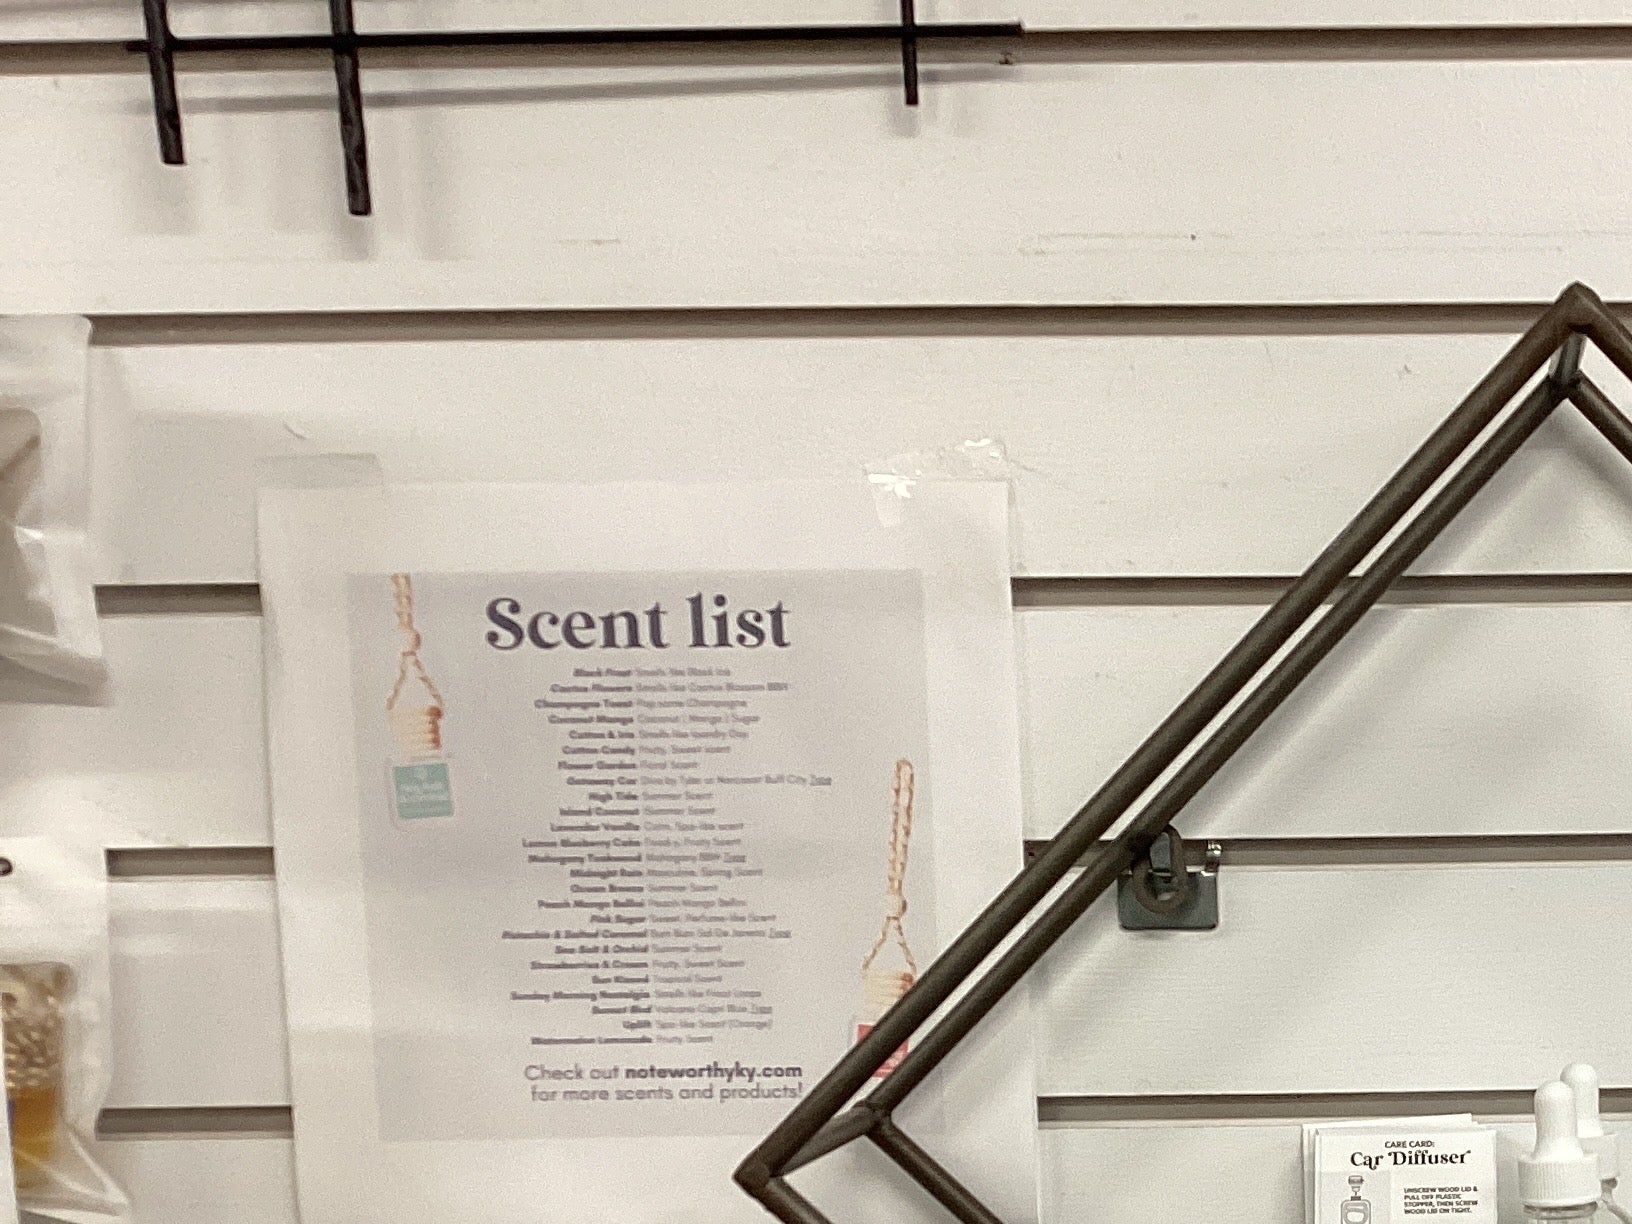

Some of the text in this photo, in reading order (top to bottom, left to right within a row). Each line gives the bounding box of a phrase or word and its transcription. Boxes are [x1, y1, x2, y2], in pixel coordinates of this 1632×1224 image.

[485, 591, 792, 650] Scent list
[524, 1061, 803, 1083] Check out noteworthyky.com
[531, 1081, 803, 1104] for more scents and products!
[1384, 1140, 1435, 1148] CARE CARD:
[1350, 1149, 1472, 1170] Car Diffuser
